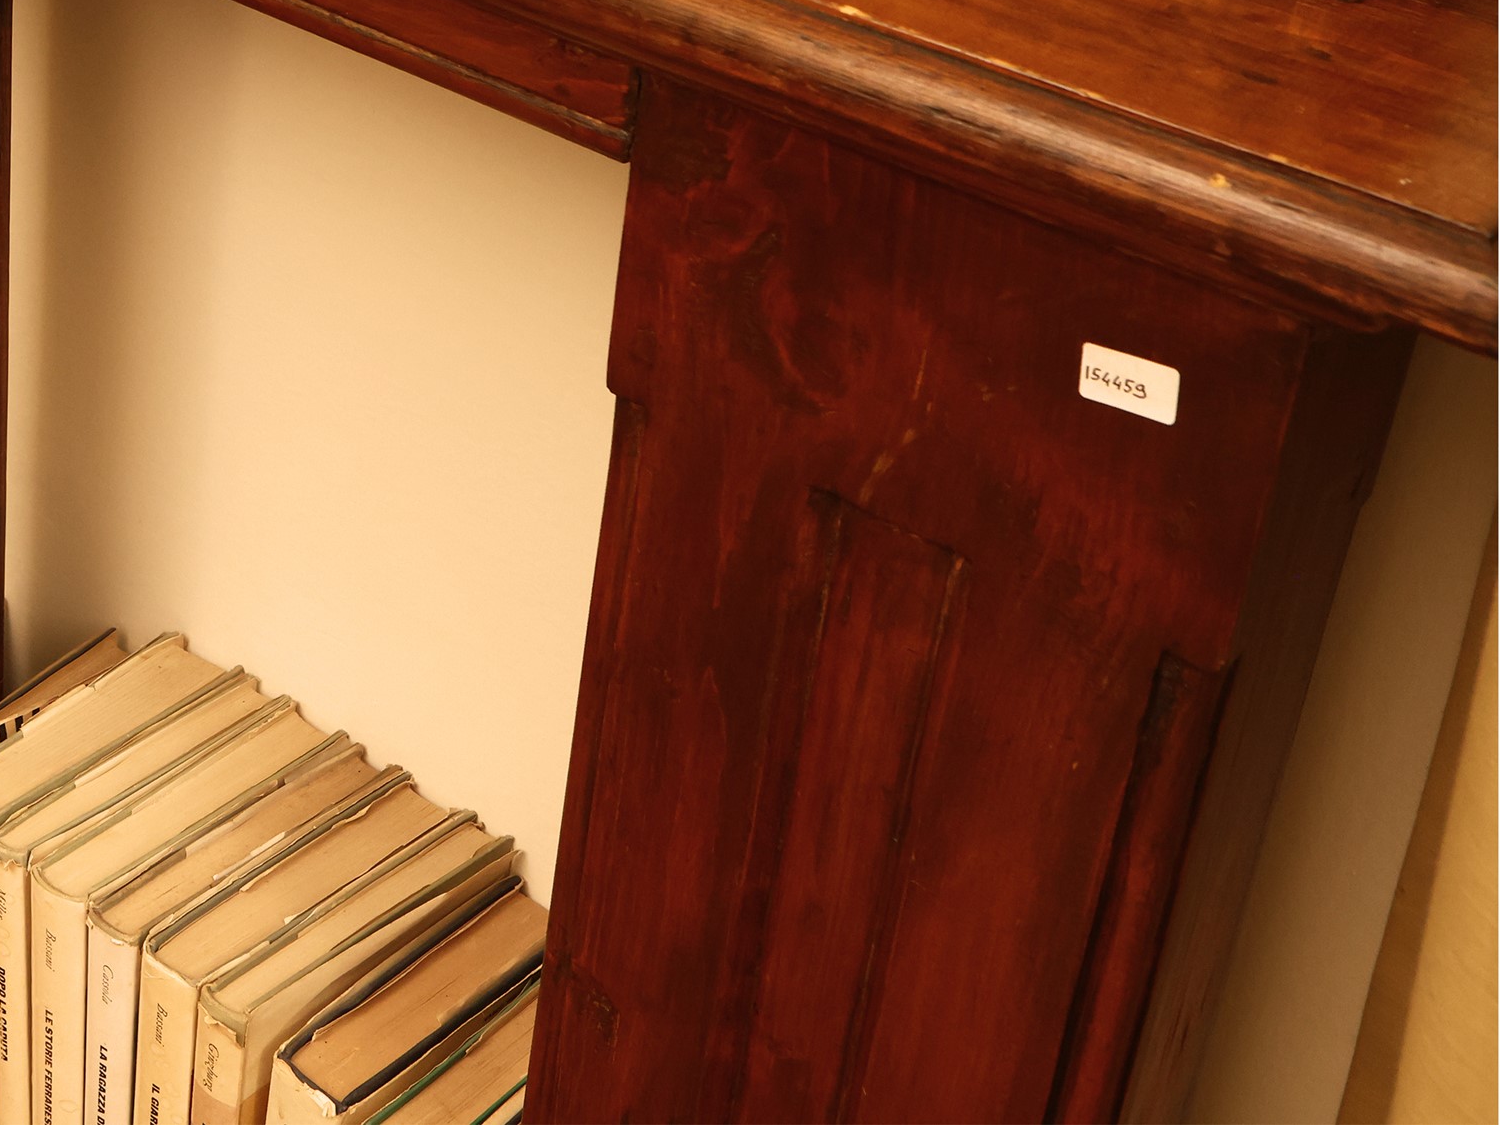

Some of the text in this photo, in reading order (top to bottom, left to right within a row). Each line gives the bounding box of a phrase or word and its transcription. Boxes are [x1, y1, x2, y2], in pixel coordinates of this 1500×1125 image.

[1085, 365, 1148, 400] 154459
[45, 928, 57, 973] Bassani
[102, 964, 114, 1006] Cassola
[0, 1017, 8, 1062] CADUTA
[156, 1003, 168, 1047] Bassani
[44, 1009, 53, 1125] LE STORIE FERRARES
[99, 1045, 108, 1061] LA
[203, 1043, 219, 1092] Ginzburg
[97, 1062, 107, 1114] RAGAZZA
[151, 1083, 161, 1094] IL
